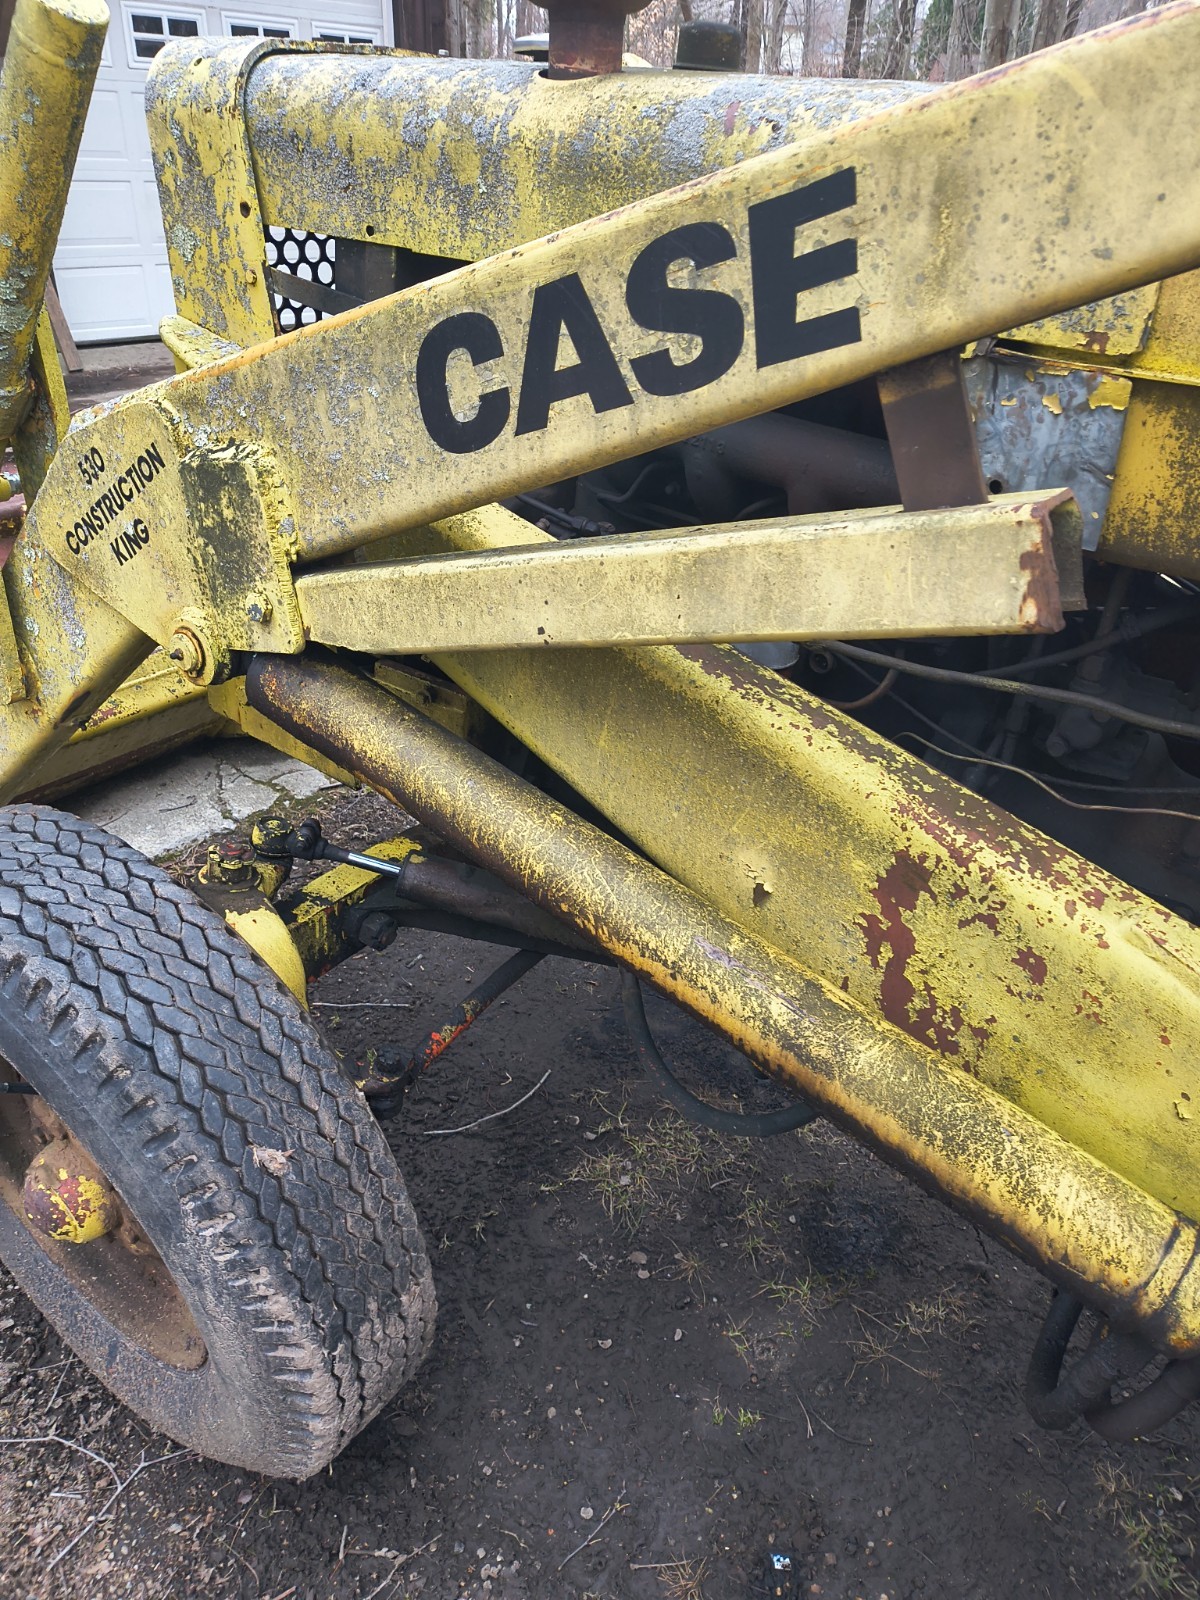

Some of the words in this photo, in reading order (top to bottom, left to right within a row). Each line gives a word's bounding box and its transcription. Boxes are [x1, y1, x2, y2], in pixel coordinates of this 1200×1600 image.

[416, 167, 862, 454] CASE
[65, 442, 166, 555] CONSTRUCTION
[78, 446, 105, 485] 530
[110, 518, 150, 567] KING
